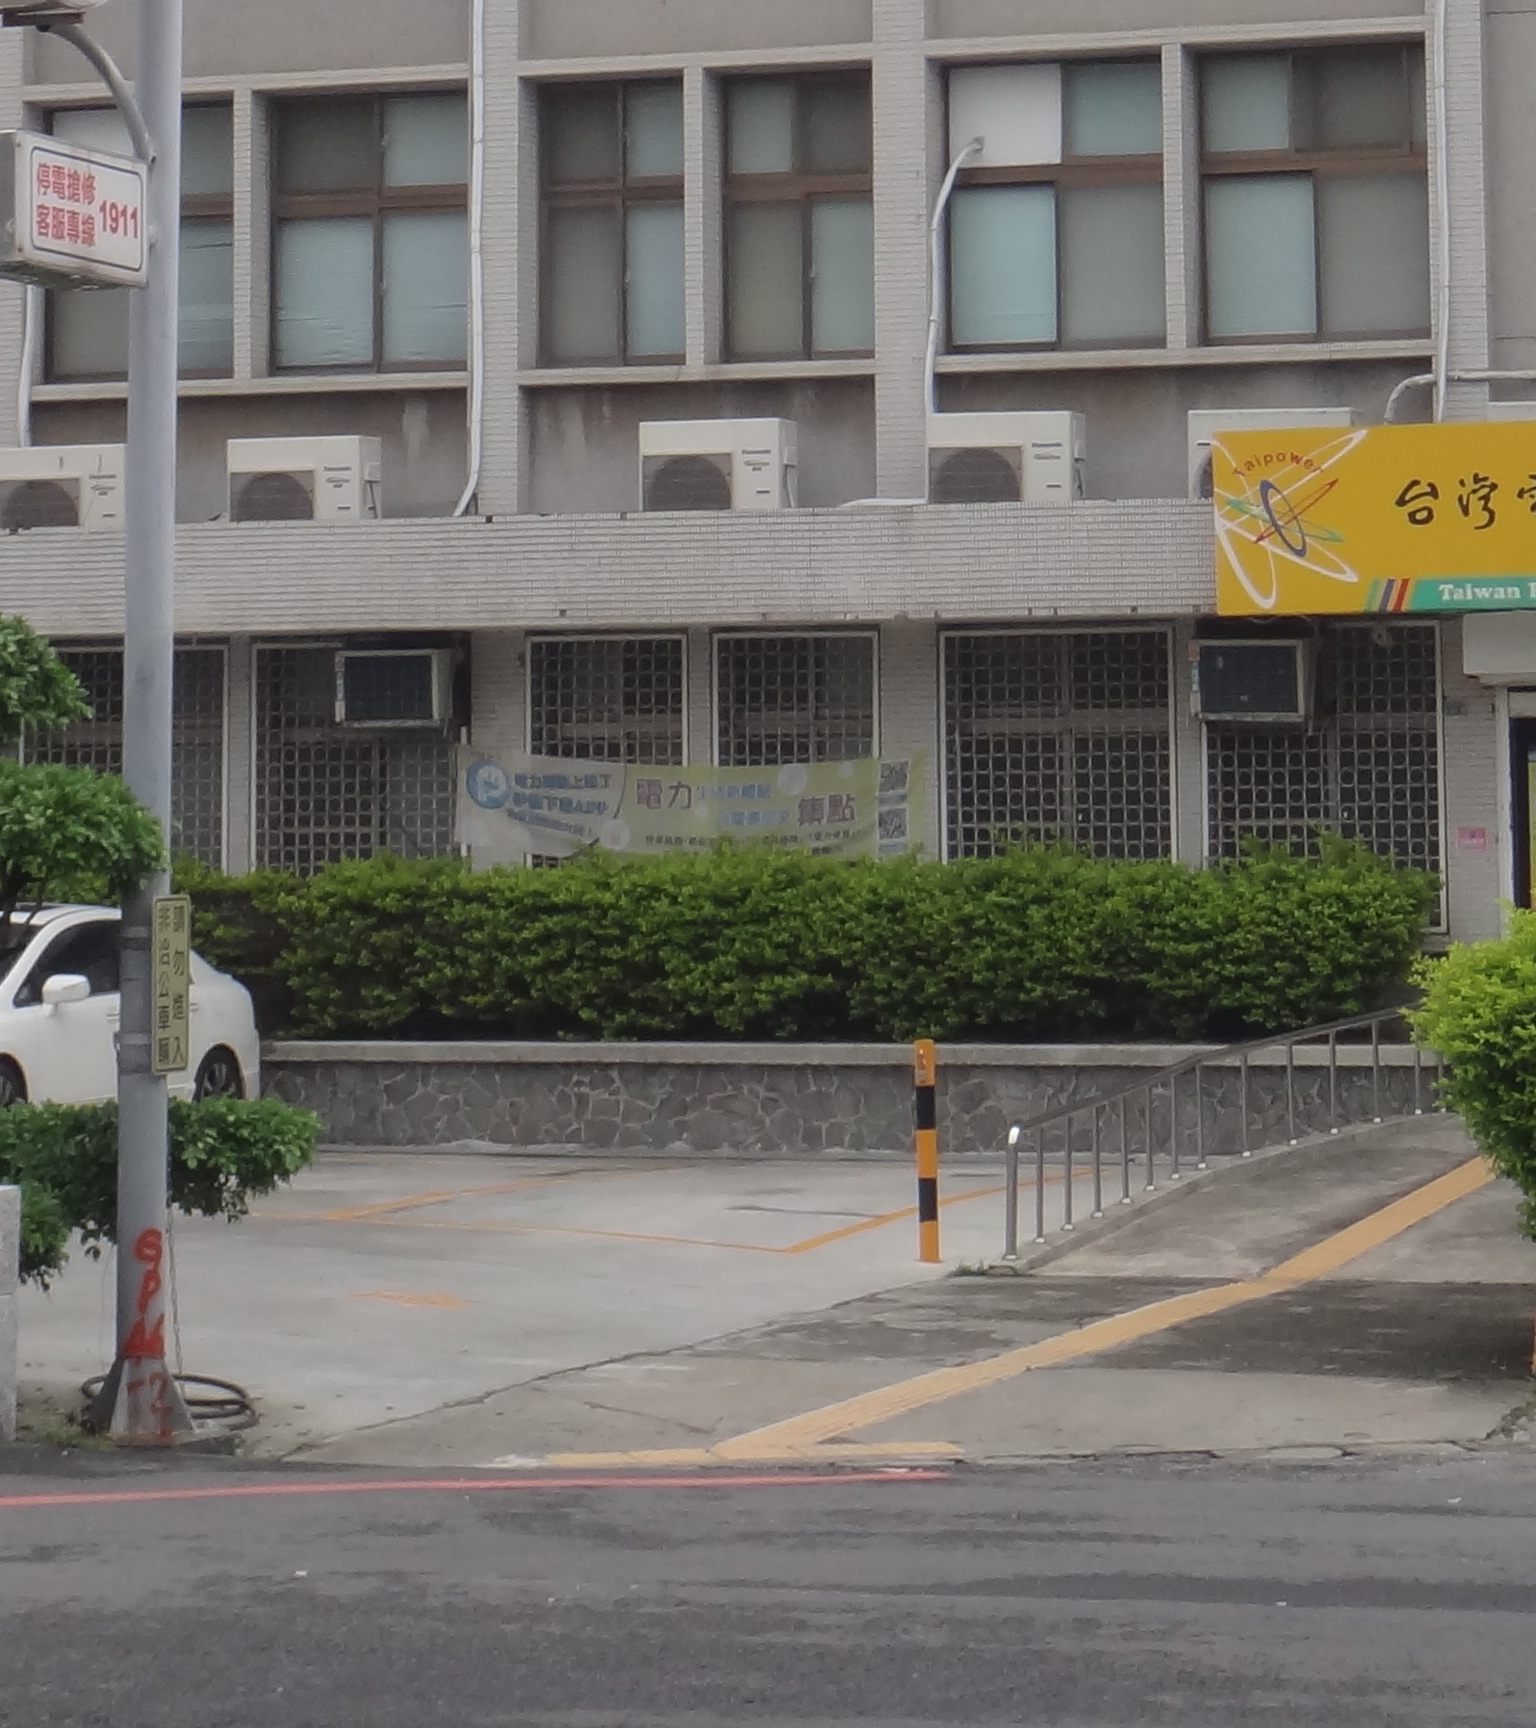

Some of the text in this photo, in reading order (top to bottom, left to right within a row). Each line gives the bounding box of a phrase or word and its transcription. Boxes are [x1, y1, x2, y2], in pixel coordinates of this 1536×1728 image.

[36, 161, 97, 207] 停電搶修
[35, 203, 97, 248] 客服專線
[99, 200, 139, 240] 1911
[1231, 450, 1325, 479] Taipower
[1438, 582, 1521, 602] Taiwan
